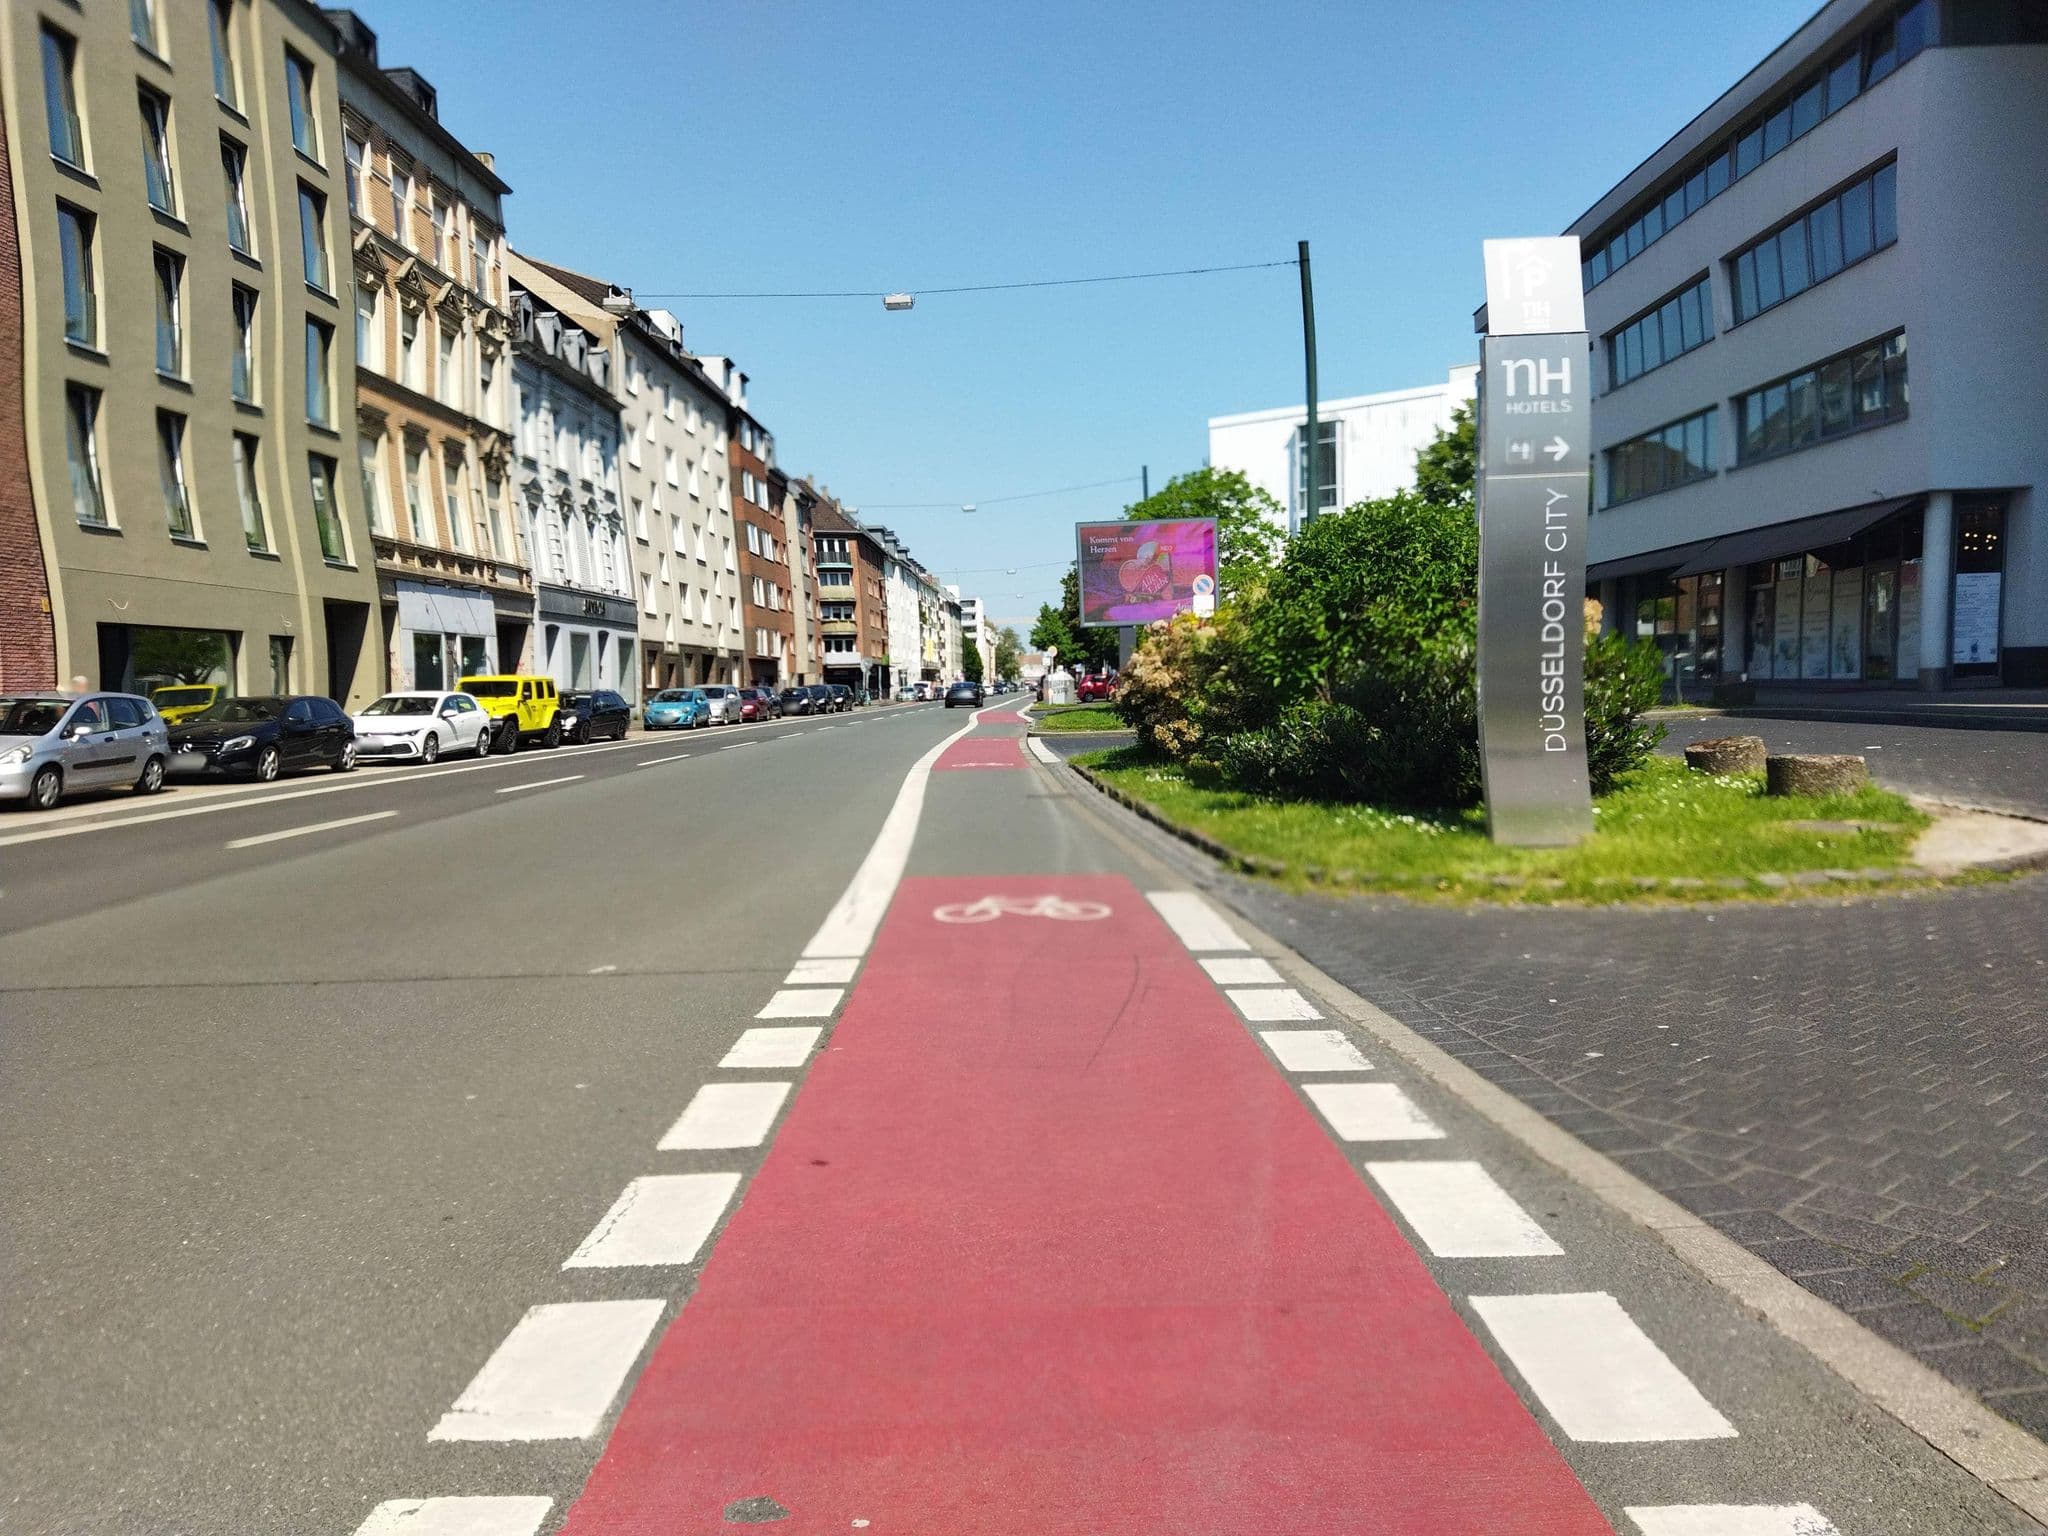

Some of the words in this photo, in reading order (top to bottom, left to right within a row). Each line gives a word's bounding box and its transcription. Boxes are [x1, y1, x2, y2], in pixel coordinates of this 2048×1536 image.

[1505, 398, 1573, 415] HOTELS
[1544, 487, 1570, 553] CITY
[1089, 536, 1119, 544] Kommt
[1089, 545, 1117, 554] Herzen
[1538, 560, 1567, 753] DÜSSELDORF
